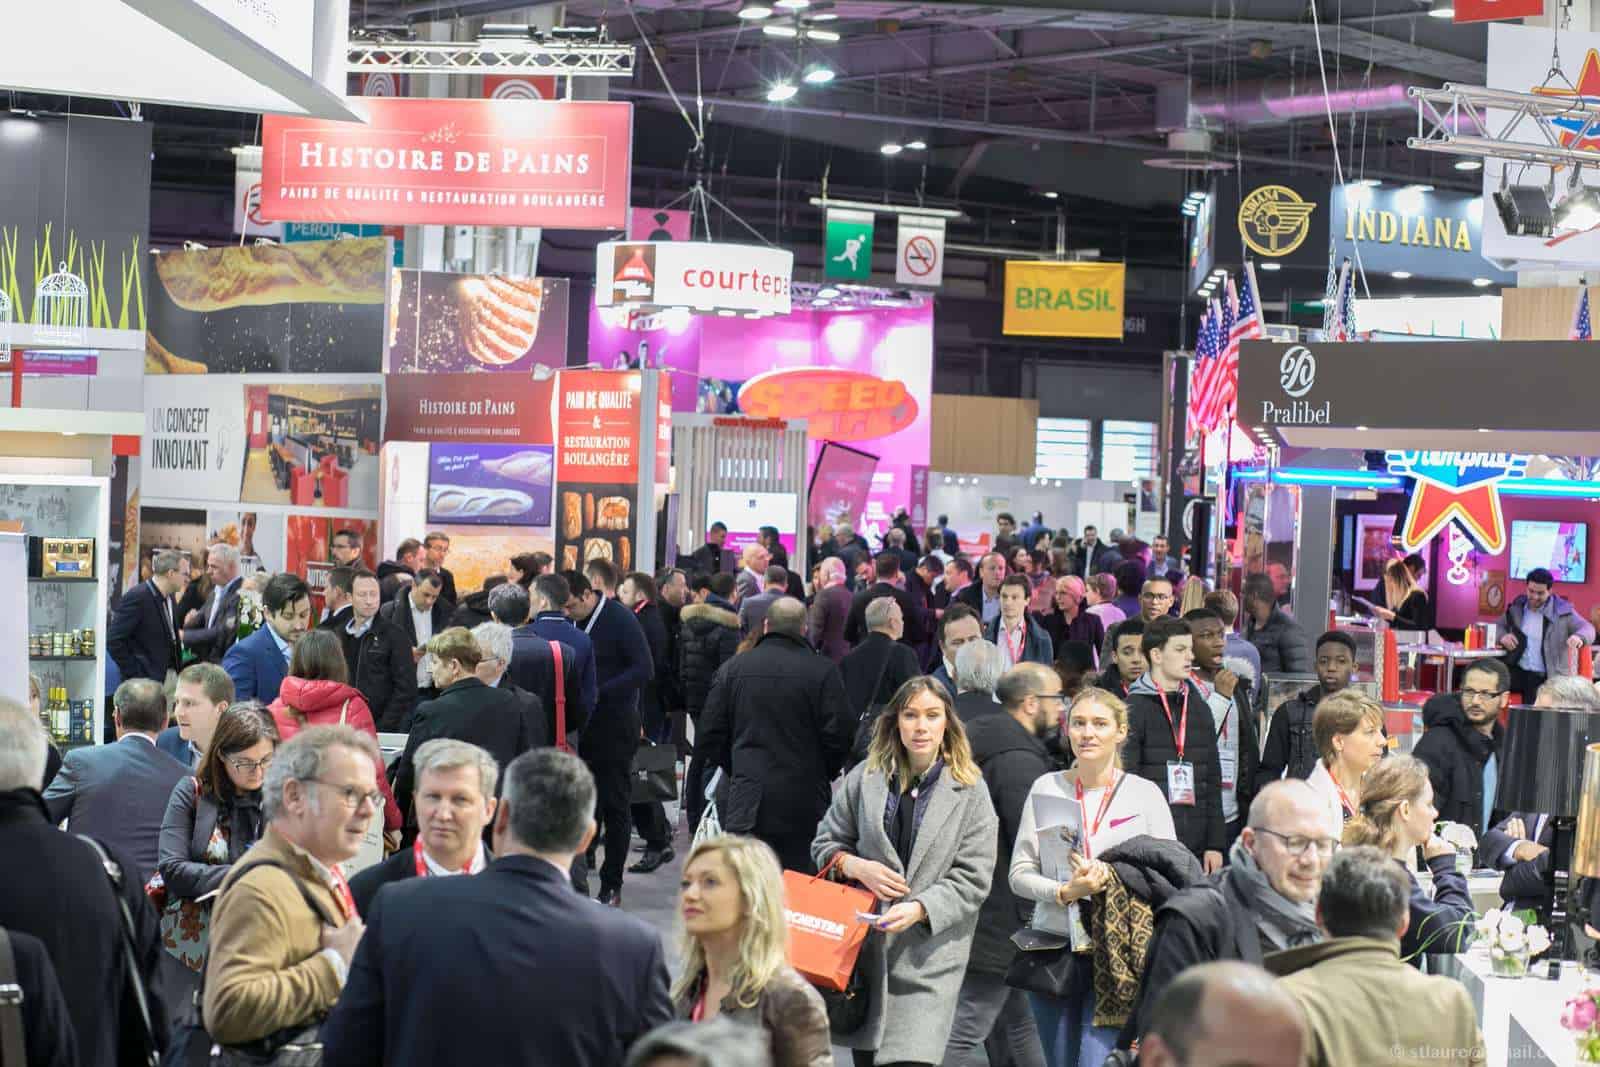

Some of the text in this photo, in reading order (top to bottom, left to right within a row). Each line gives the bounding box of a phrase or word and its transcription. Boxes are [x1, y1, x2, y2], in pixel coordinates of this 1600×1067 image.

[300, 141, 590, 175] HISTOIRE DE PAINS
[1344, 208, 1472, 252] INDIANA
[1015, 286, 1117, 312] BRASIL
[167, 407, 210, 433] CONCEPT
[419, 399, 516, 416] HISTOIRE DE PAINS
[1262, 401, 1331, 424] Pralibel
[152, 438, 208, 471] INNOVANT
[564, 435, 630, 449] RESTAURATION
